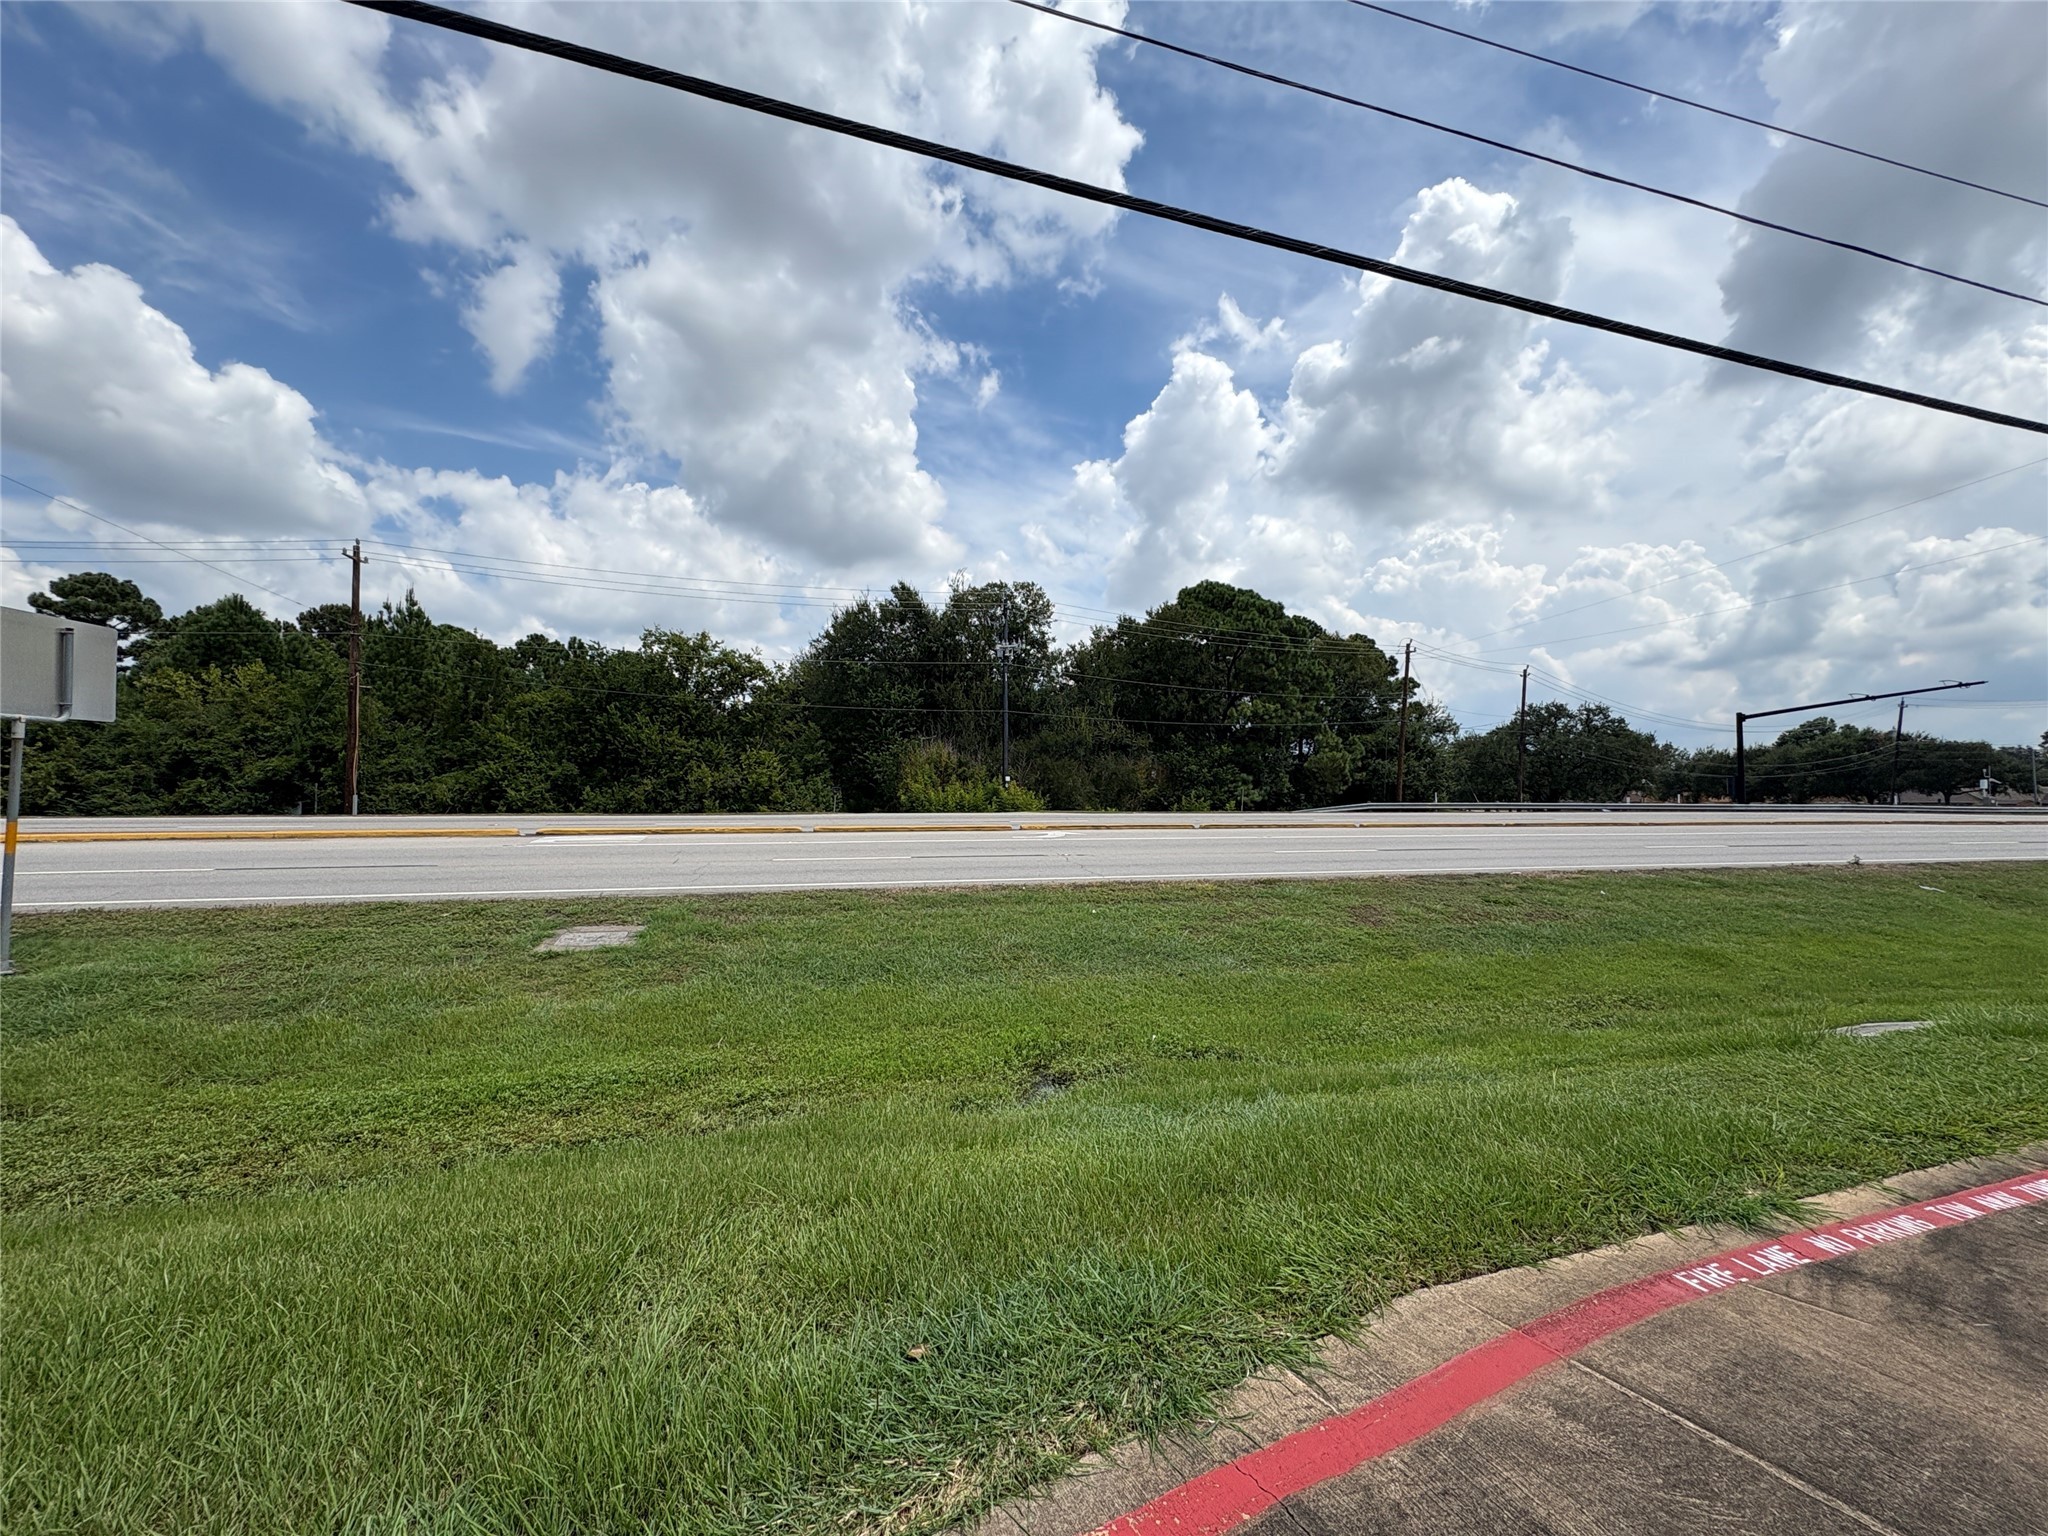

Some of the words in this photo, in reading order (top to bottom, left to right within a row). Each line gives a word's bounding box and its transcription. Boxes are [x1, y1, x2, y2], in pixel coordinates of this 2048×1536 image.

[1672, 1263, 1749, 1292] FIRE
[1730, 1245, 1812, 1275] LANE
[1802, 1235, 1856, 1255] NO
[1839, 1215, 1936, 1245] PARKING
[1924, 1201, 1987, 1221] TOW
